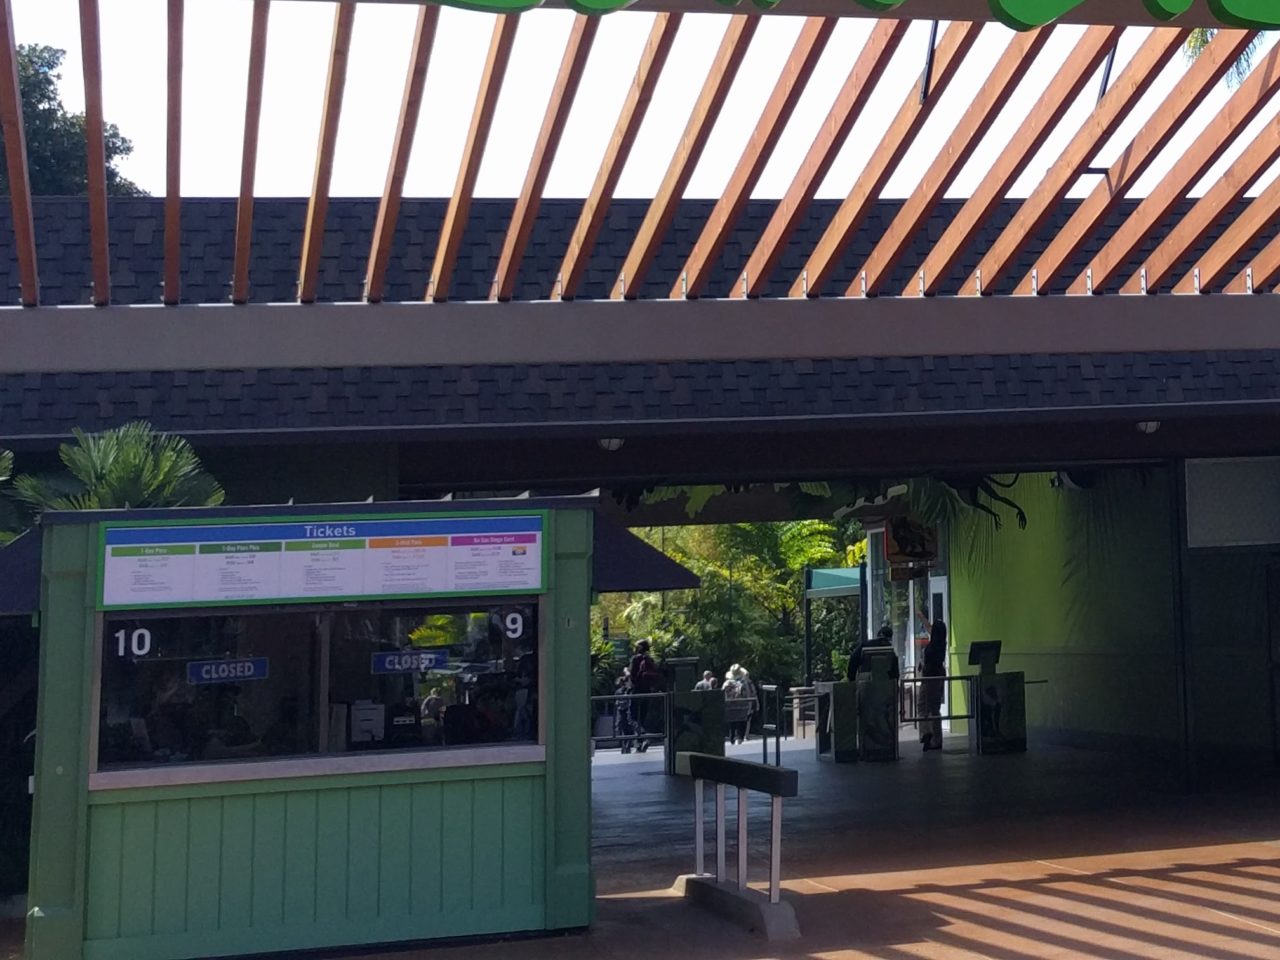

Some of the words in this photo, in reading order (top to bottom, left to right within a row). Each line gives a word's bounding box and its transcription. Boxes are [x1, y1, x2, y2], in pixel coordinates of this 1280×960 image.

[304, 525, 357, 538] Tickets
[505, 613, 523, 639] 9
[114, 628, 151, 657] 10
[201, 662, 254, 679] CLOSED
[385, 654, 436, 670] CLOSED
